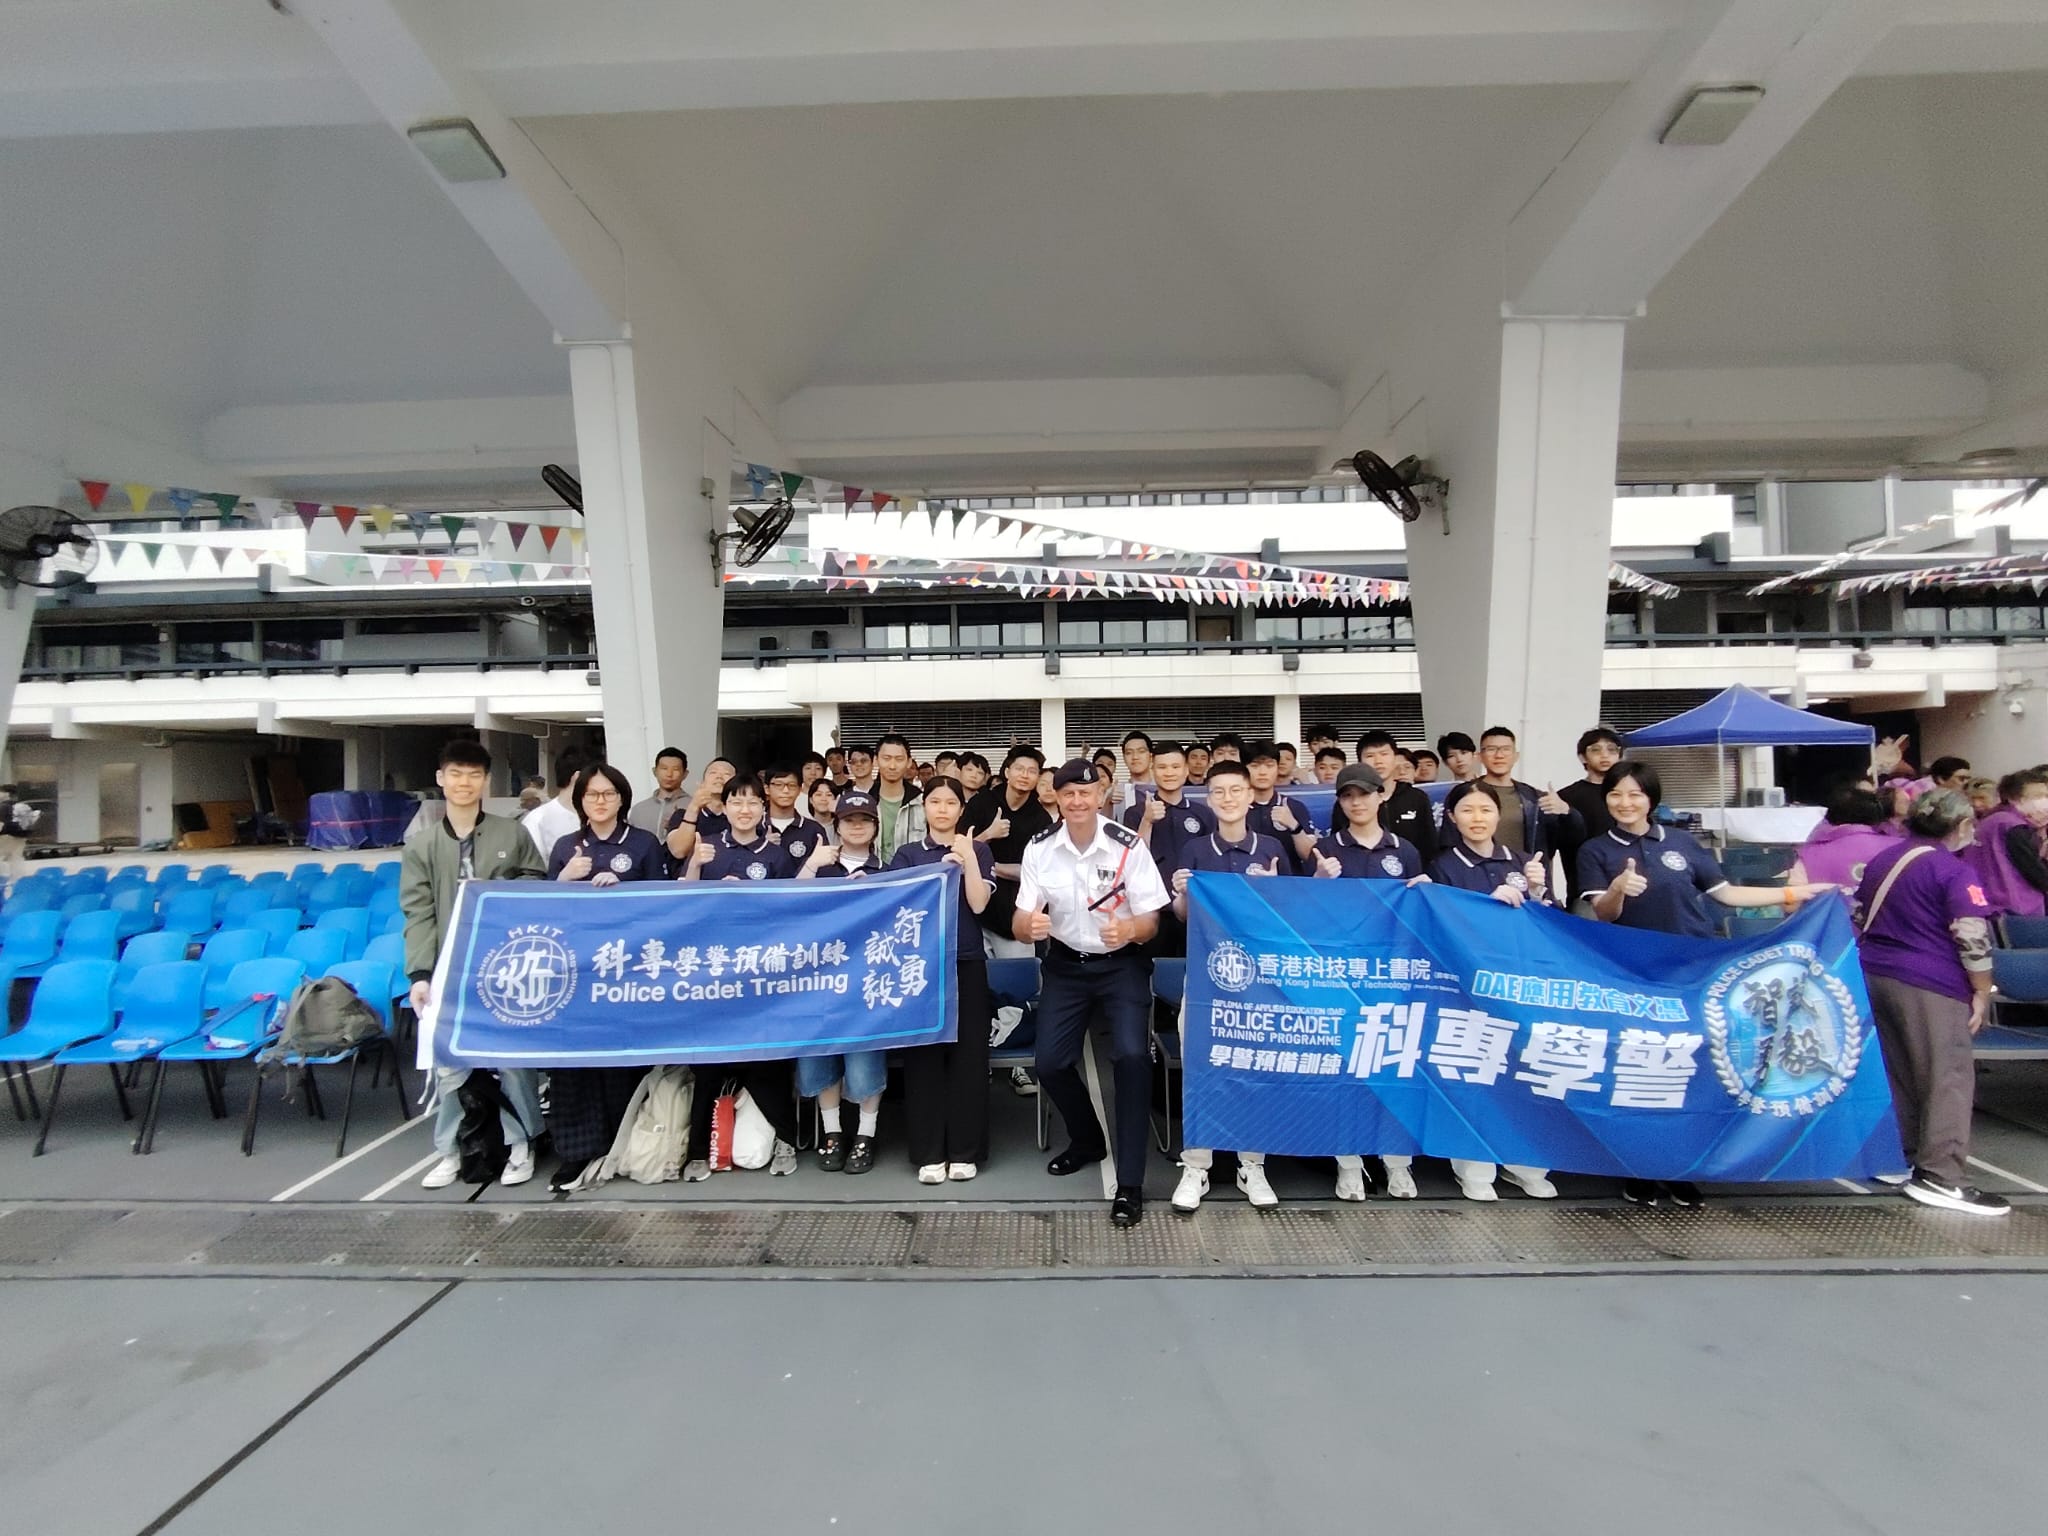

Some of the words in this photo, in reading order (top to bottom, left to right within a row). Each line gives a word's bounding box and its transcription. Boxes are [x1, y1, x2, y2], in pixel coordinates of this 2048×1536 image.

[507, 924, 564, 939] HKIT
[591, 938, 851, 981] 科專學警預備訓練
[1257, 953, 1431, 981] 香港科技專上書院
[1706, 966, 1743, 998] POLICE
[1737, 947, 1784, 969] CADET
[591, 981, 666, 1003] Police
[672, 980, 744, 1001] Cadet
[750, 971, 849, 997] Training
[1257, 975, 1283, 988] Hong
[1284, 978, 1310, 989] Kong
[1312, 978, 1350, 989] Institute
[1351, 980, 1361, 989] of
[1362, 980, 1412, 992] Technology
[1210, 1007, 1275, 1032] POLICE
[1280, 1013, 1343, 1035] CADET
[1210, 1026, 1265, 1043] TRAINING
[1269, 1031, 1342, 1046] PROGRAMME
[1209, 1044, 1343, 1075] 學警預備訓練
[1347, 1001, 1704, 1110] 科專學警
[709, 1130, 720, 1170] Coffee
